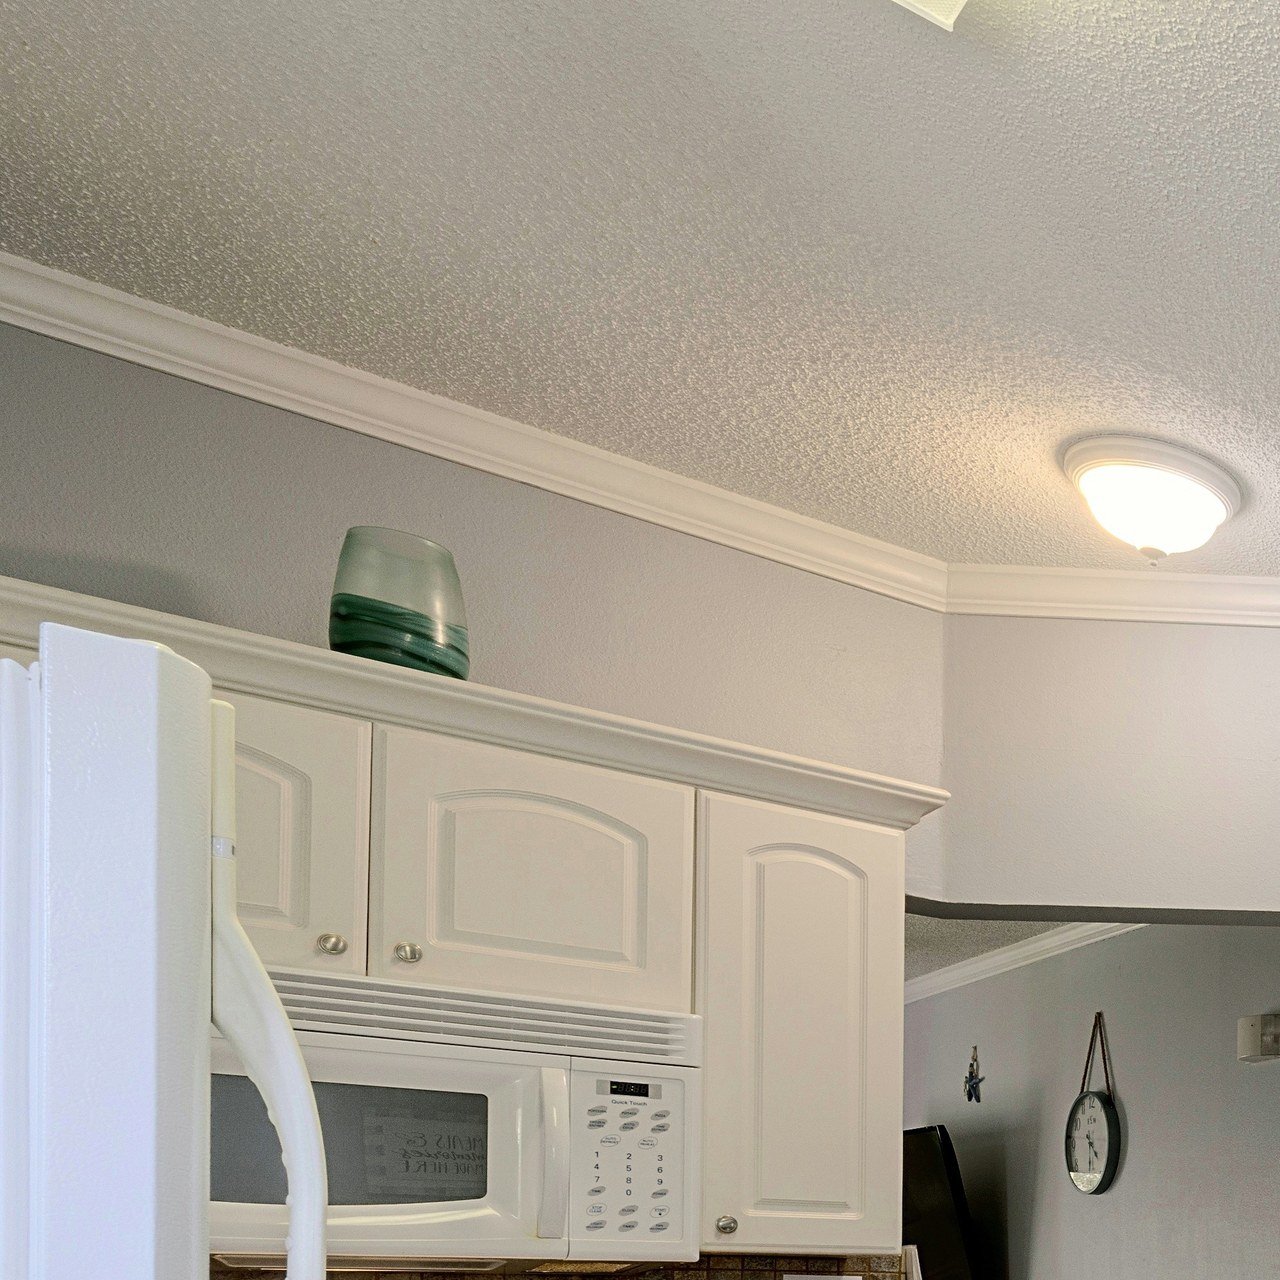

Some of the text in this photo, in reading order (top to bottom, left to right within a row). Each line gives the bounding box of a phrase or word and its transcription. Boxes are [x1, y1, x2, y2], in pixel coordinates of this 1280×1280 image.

[626, 1164, 632, 1172] 5
[657, 1166, 663, 1174] 6
[595, 1175, 600, 1183] 7
[626, 1176, 632, 1184] 8
[657, 1178, 663, 1186] 9
